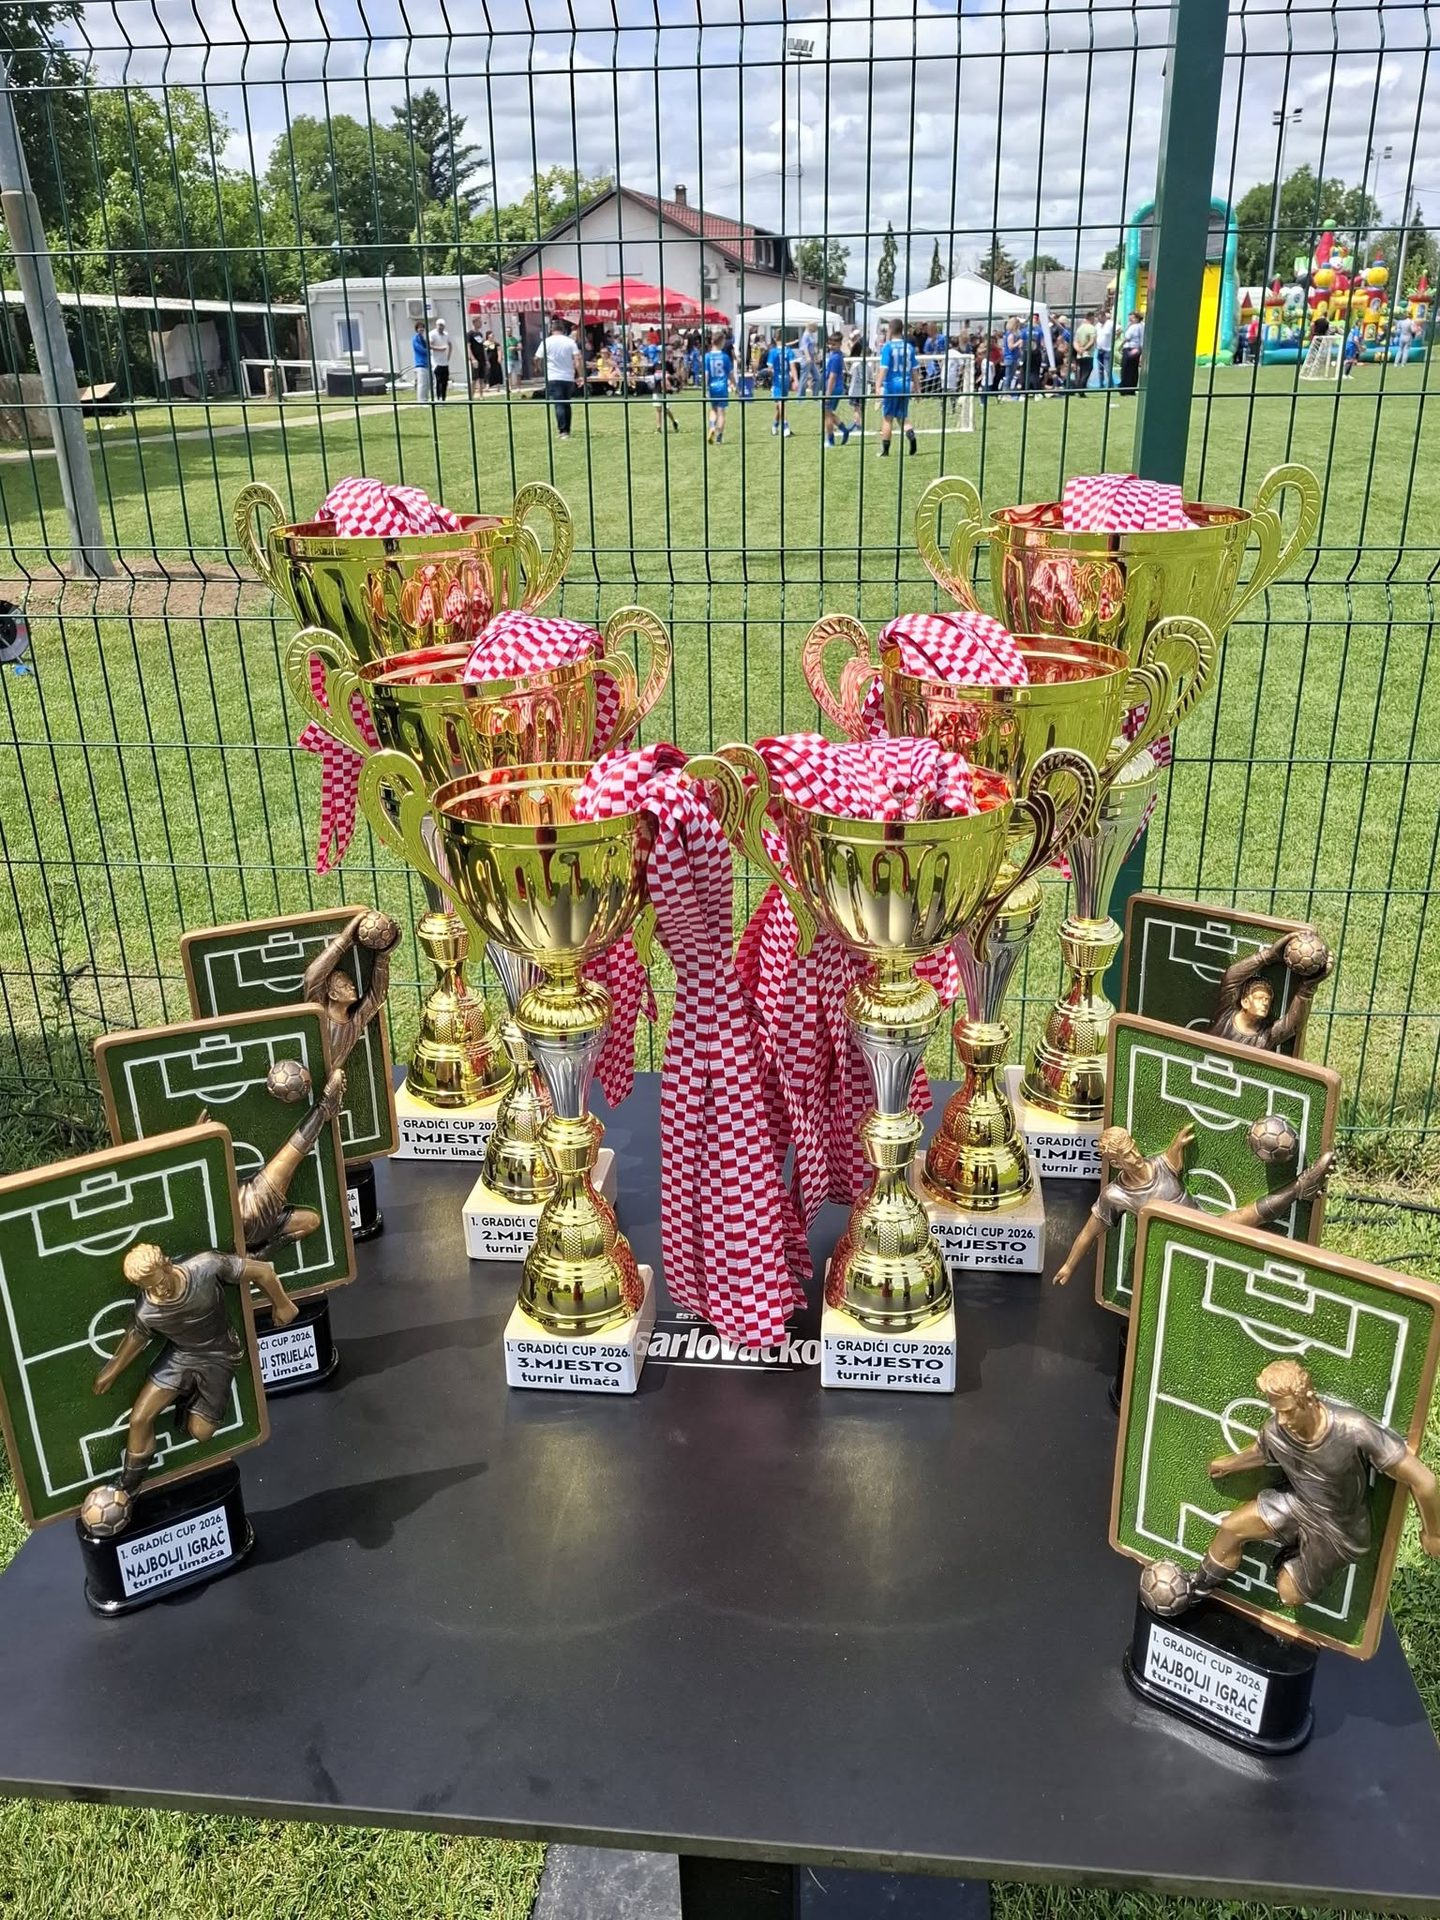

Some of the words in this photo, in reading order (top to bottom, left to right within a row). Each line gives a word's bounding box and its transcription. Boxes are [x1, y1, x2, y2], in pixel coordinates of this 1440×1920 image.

[710, 360, 724, 377] 18
[403, 1118, 449, 1129] GRADIĆI
[453, 1121, 475, 1130] CUP
[479, 1122, 497, 1131] 202
[1025, 1136, 1032, 1145] 1.
[1037, 1136, 1086, 1147] GRADIĆI
[413, 1146, 447, 1155] turnir
[451, 1146, 487, 1156] limač
[1034, 1148, 1103, 1161] 1.MJES
[1042, 1163, 1078, 1173] turnir
[471, 1217, 478, 1226] 1.
[482, 1216, 525, 1227] GRADIĆI
[482, 1231, 537, 1241] 2.MJE
[931, 1224, 977, 1236] GRADIĆI
[981, 1228, 1004, 1237] CUP
[1008, 1229, 1035, 1239] 2026.
[486, 1244, 523, 1253] turnir
[945, 1253, 970, 1262] rnir
[975, 1254, 1023, 1265] prstića
[676, 1312, 698, 1320] EST.
[272, 1337, 288, 1347] CUP
[291, 1331, 312, 1343] 2026.
[506, 1342, 514, 1351] 1.
[517, 1342, 567, 1354] GRADIĆI
[572, 1346, 597, 1356] CUP
[601, 1347, 631, 1358] 2026.
[825, 1340, 832, 1350] 1.
[837, 1340, 888, 1352] GRADIĆI
[893, 1343, 918, 1354] CUP
[923, 1345, 953, 1355] 2026.
[271, 1345, 315, 1367] STRIJELAC
[835, 1355, 943, 1370] 3.MJESTO
[273, 1362, 312, 1377] limača
[517, 1358, 622, 1373] 3.MJESTO
[521, 1372, 564, 1384] turnir
[570, 1374, 620, 1387] limača
[837, 1370, 881, 1381] turnir
[887, 1374, 941, 1384] prstića
[121, 1550, 128, 1559] 1.
[131, 1532, 173, 1555] GRADIĆI
[176, 1524, 196, 1538] CUP
[200, 1514, 223, 1530] 2026.
[125, 1545, 183, 1581] NAJBOLJI
[188, 1526, 225, 1557] IGRAČ
[133, 1568, 174, 1589] turnir
[179, 1549, 224, 1571] limača
[1153, 1631, 1159, 1643] 1.
[1163, 1637, 1207, 1665] GRADIĆI
[1211, 1660, 1232, 1676] CUP
[1235, 1672, 1262, 1693] 2026.
[1150, 1650, 1211, 1692] NAJBOLJI
[1215, 1681, 1258, 1715] IGRAČ
[1151, 1670, 1194, 1695] turnir
[1199, 1694, 1252, 1726] prstića
